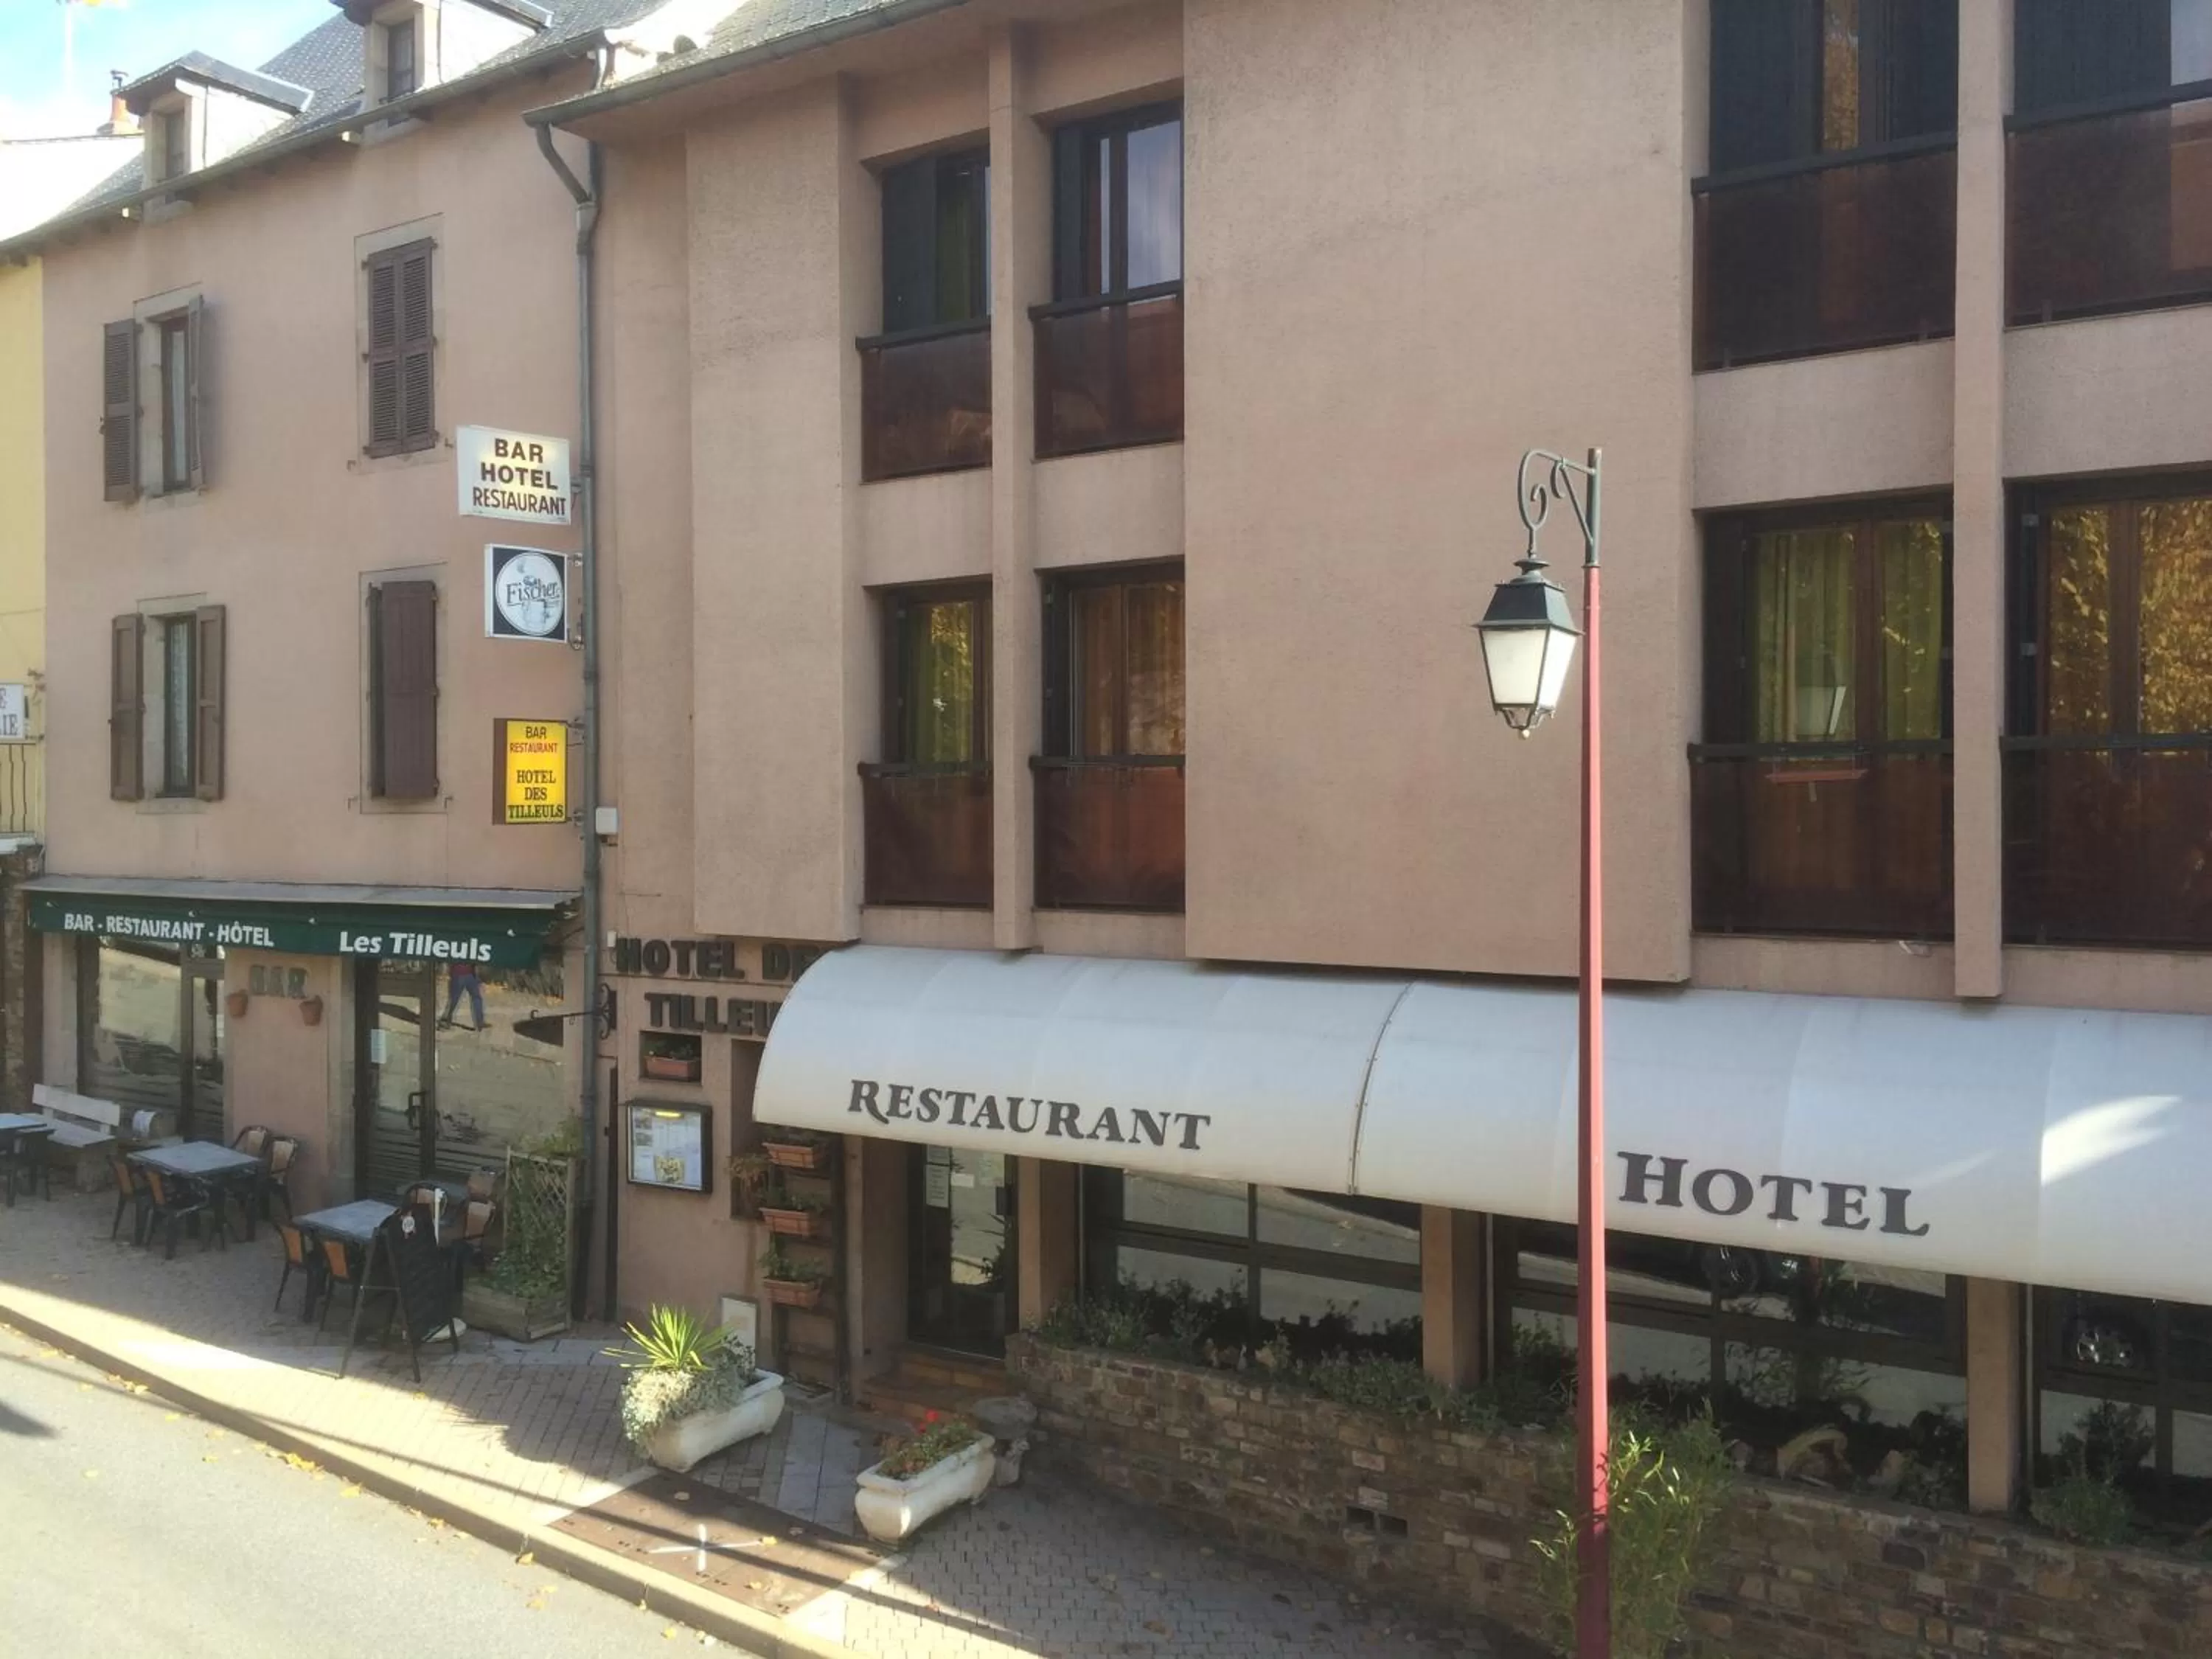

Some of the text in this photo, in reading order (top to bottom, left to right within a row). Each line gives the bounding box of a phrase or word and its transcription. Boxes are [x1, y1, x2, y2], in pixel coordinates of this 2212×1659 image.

[495, 438, 543, 463] BAR
[481, 462, 558, 490] HOTEL
[473, 487, 566, 515] RESTAURANT
[506, 577, 558, 604] Fischer
[526, 726, 547, 739] BAR
[510, 742, 558, 754] RESTAURANT
[517, 769, 556, 784] HOTEL
[524, 787, 548, 801] DES
[508, 804, 564, 819] TILLEULS
[64, 913, 94, 932] BAR
[106, 915, 205, 940] RESTAURANT
[217, 921, 274, 947] HÔTEL
[339, 931, 492, 961] Les Tilleuls
[615, 937, 745, 979] HOTEL
[250, 964, 307, 999] BAR
[848, 1079, 1211, 1150] RESTAURANT
[1618, 1151, 1930, 1237] HOTEL
